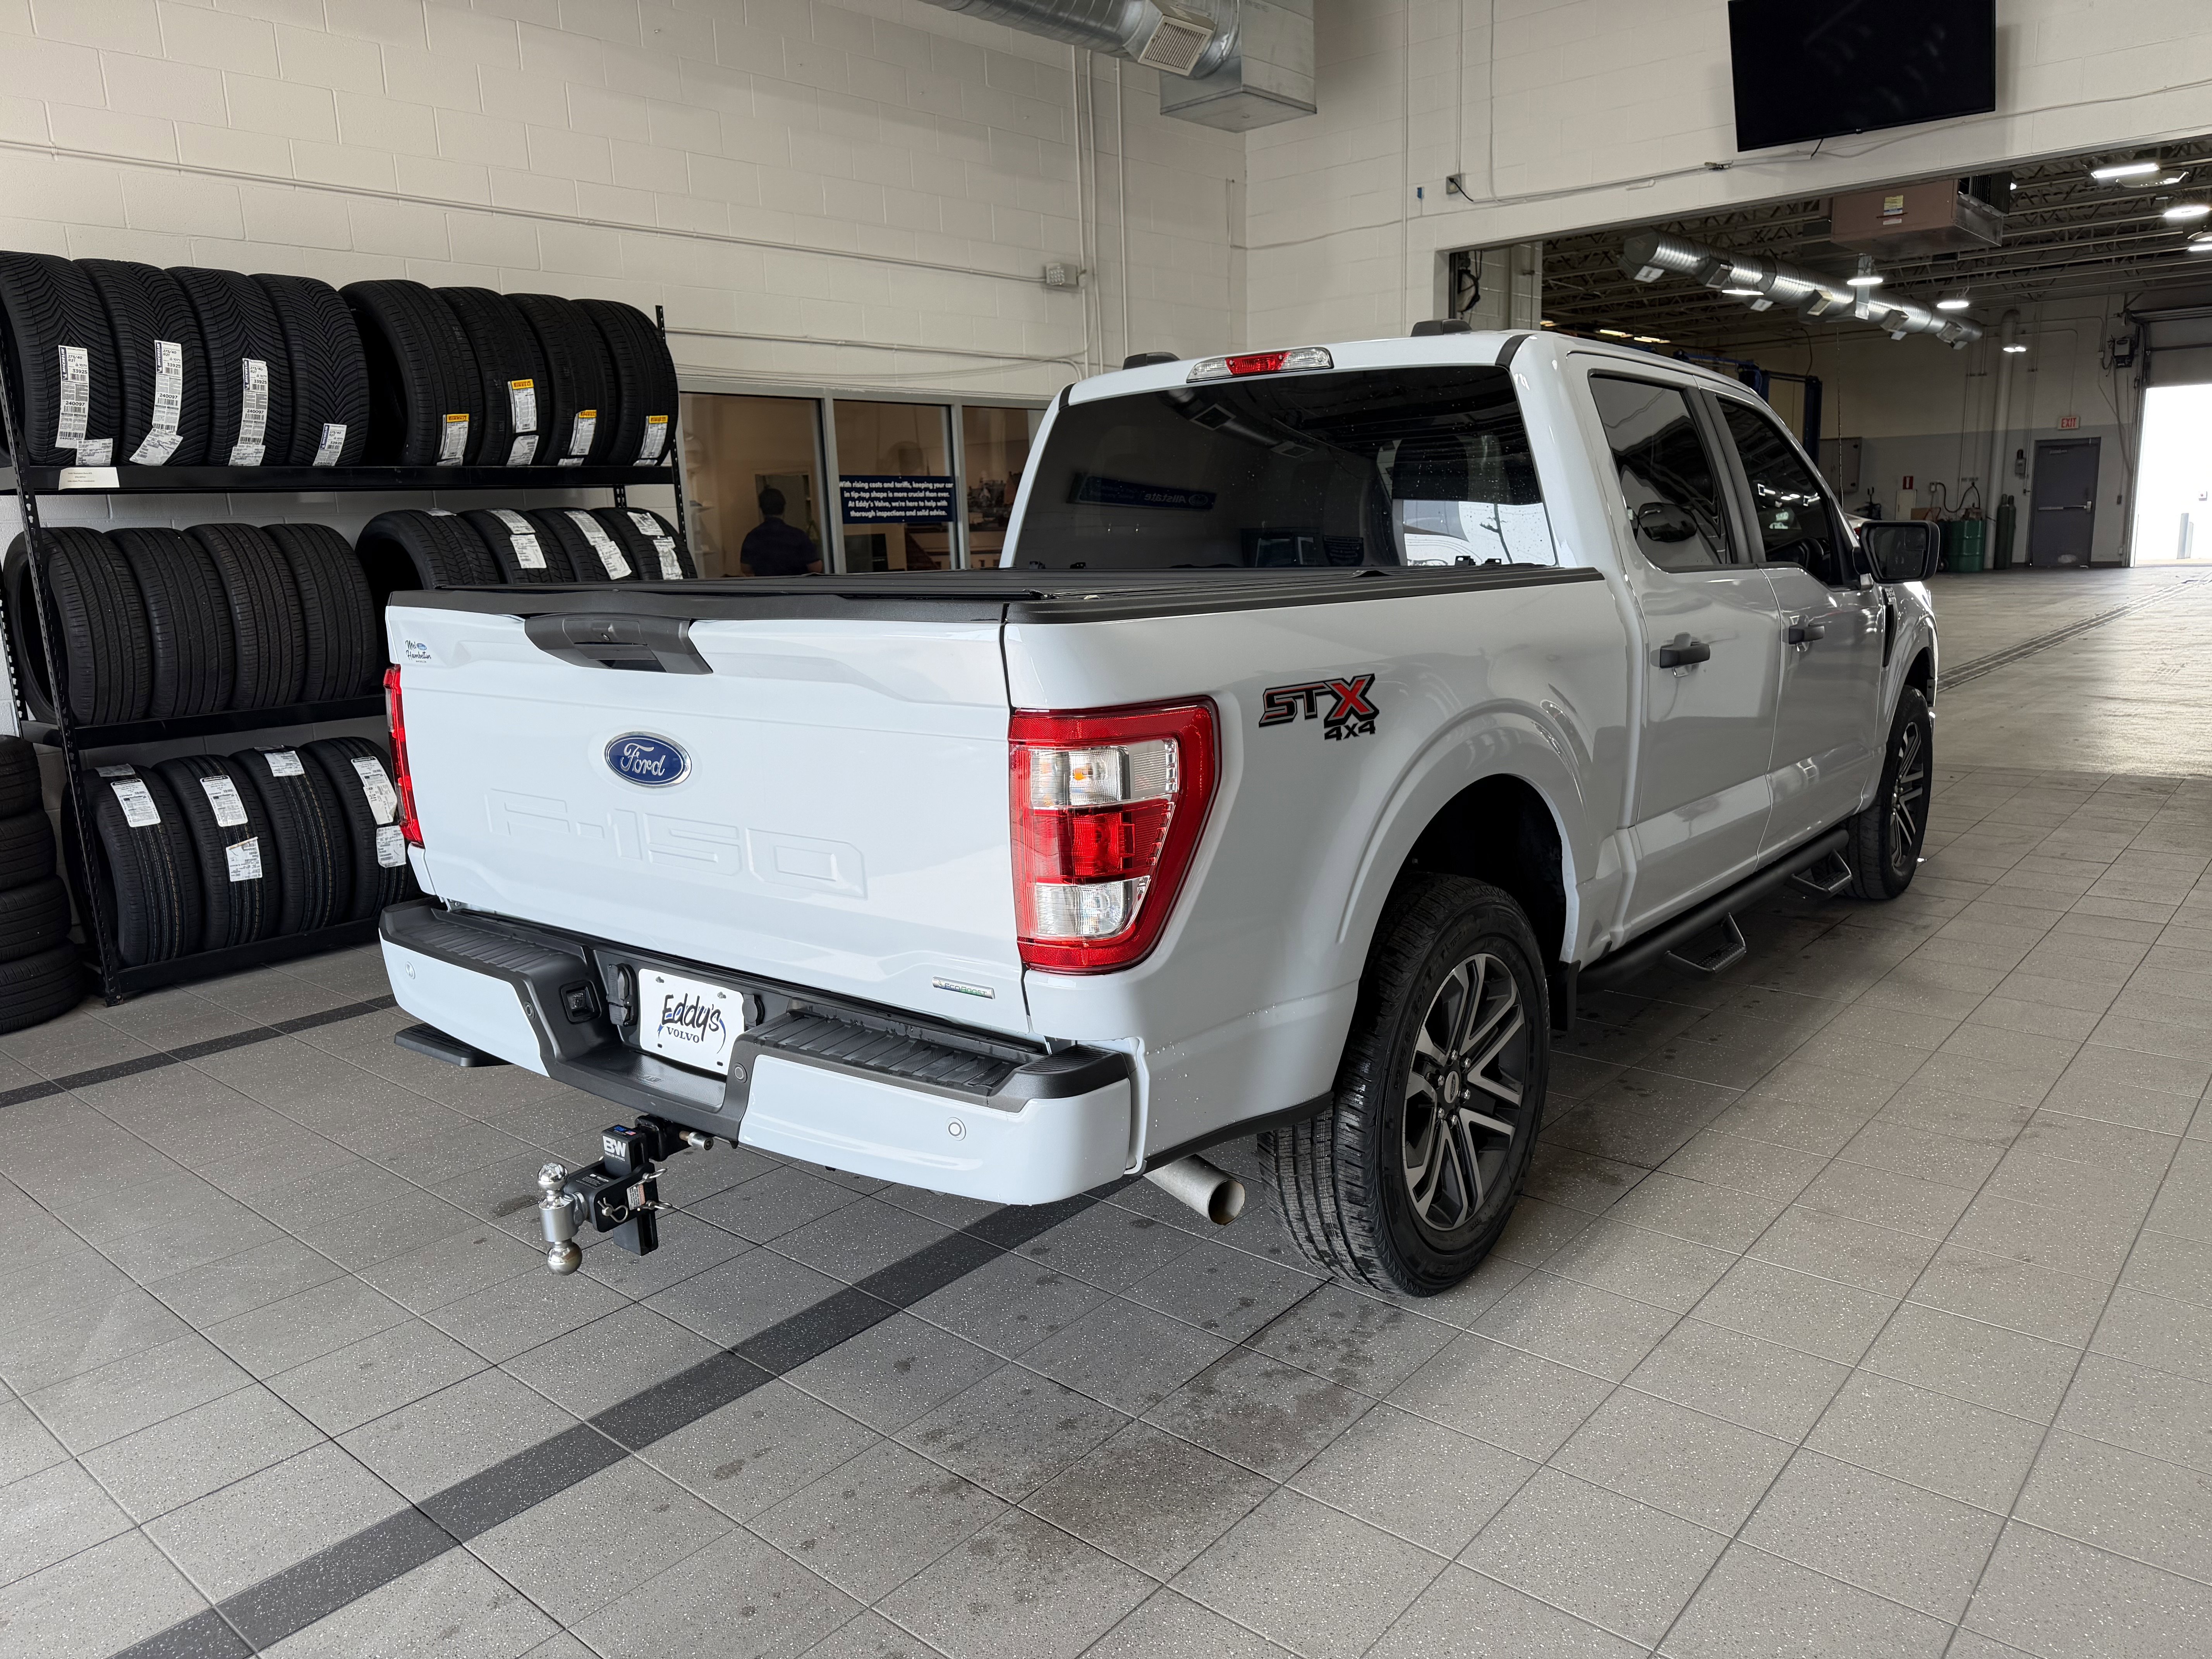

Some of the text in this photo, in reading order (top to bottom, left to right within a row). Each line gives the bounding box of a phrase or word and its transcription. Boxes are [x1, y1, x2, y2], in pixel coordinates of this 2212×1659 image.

[2061, 418, 2076, 428] EXIT
[853, 481, 868, 489] rising
[851, 491, 870, 499] tip-top
[871, 491, 887, 499] shape
[405, 640, 417, 651] Mel
[1259, 673, 1379, 728] STX
[620, 743, 666, 776] Ford
[485, 788, 868, 900] F-150
[662, 993, 721, 1042] Eddy's
[666, 1026, 700, 1043] VOLVO
